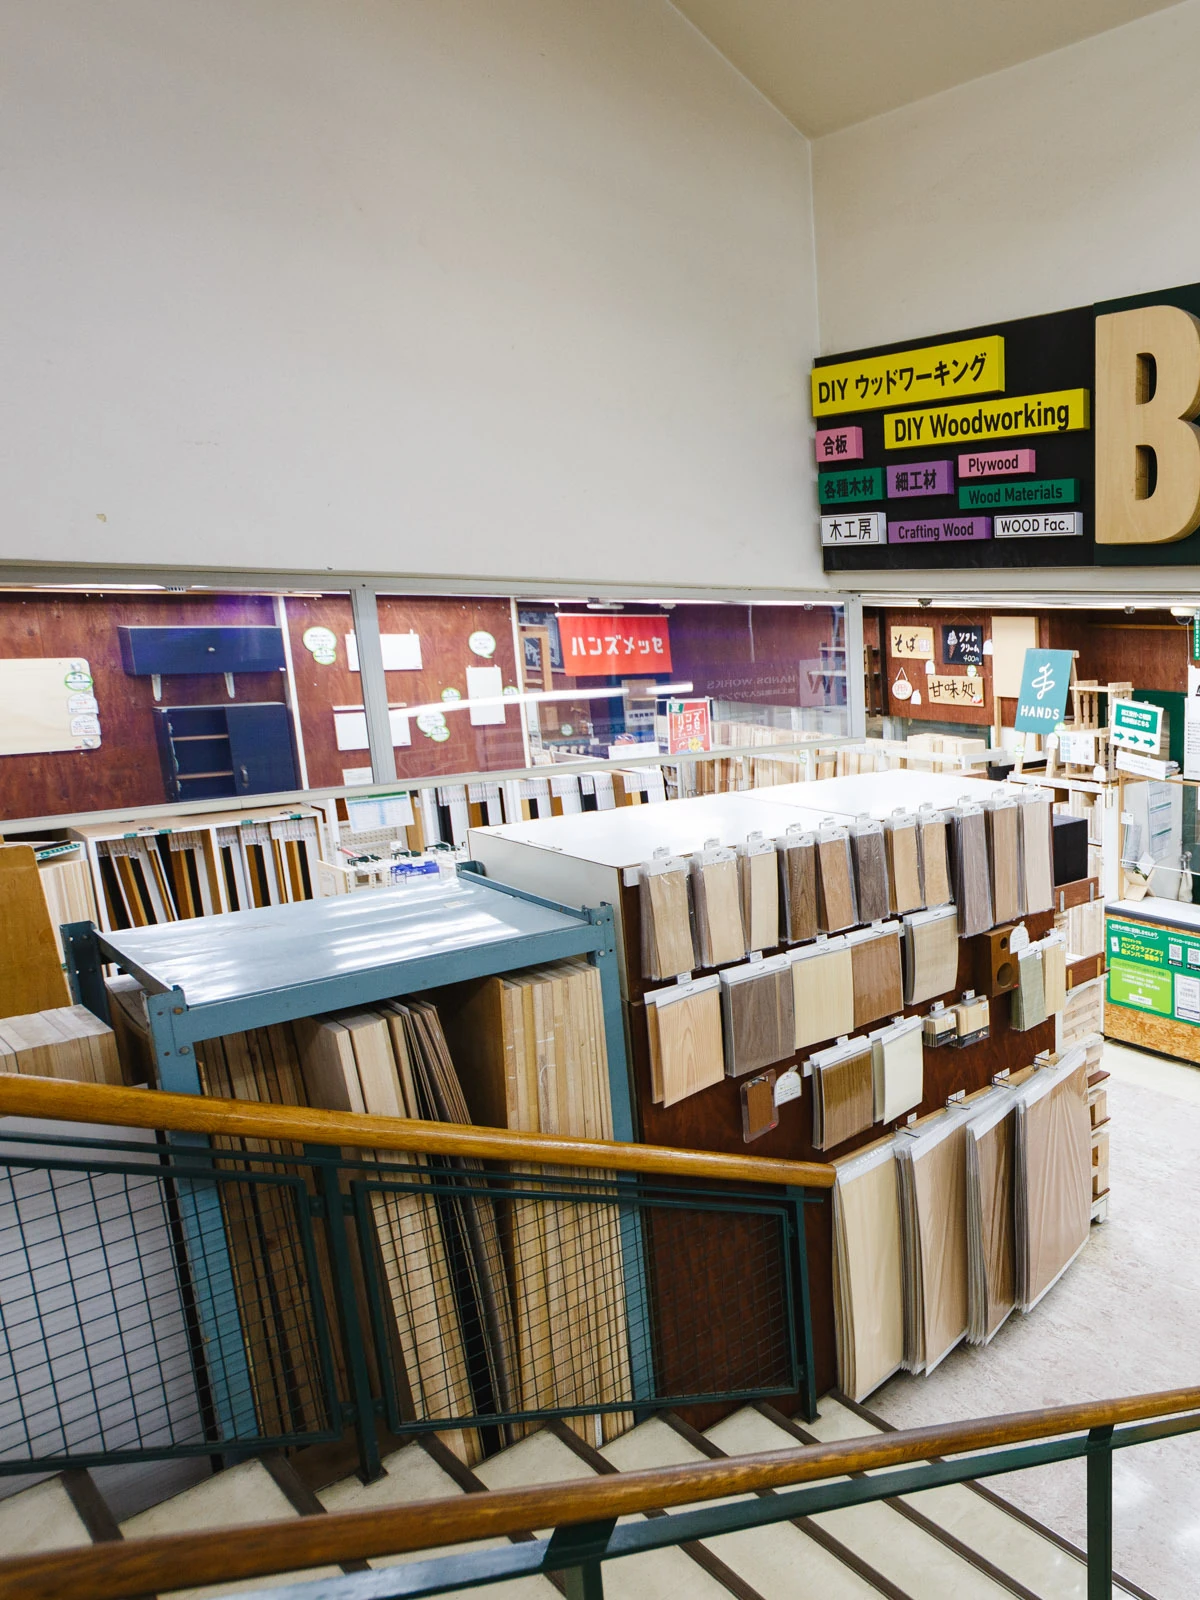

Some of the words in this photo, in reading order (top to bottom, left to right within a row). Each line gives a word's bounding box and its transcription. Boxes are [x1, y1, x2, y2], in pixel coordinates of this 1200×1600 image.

[818, 377, 848, 403] DIY
[855, 352, 987, 400] ウッドワーキング
[895, 416, 924, 442] DIY
[929, 401, 1070, 438] Woodworking
[823, 434, 848, 456] 合板
[968, 454, 1019, 476] Plywood
[824, 475, 874, 499] 各種木材
[895, 468, 937, 491] 細工材
[968, 488, 1002, 505] Wood
[1005, 484, 1063, 502] Materials
[830, 518, 872, 541] 木工房
[898, 524, 940, 540] Crafting
[944, 521, 974, 537] Wood
[1000, 519, 1041, 534] WOOD
[1044, 517, 1070, 532] Fac.
[571, 632, 664, 657] ハンズメッセ
[894, 633, 919, 653] そば
[958, 631, 978, 643] ソフト
[929, 679, 976, 699] 甘味処
[1020, 704, 1060, 720] HANDS
